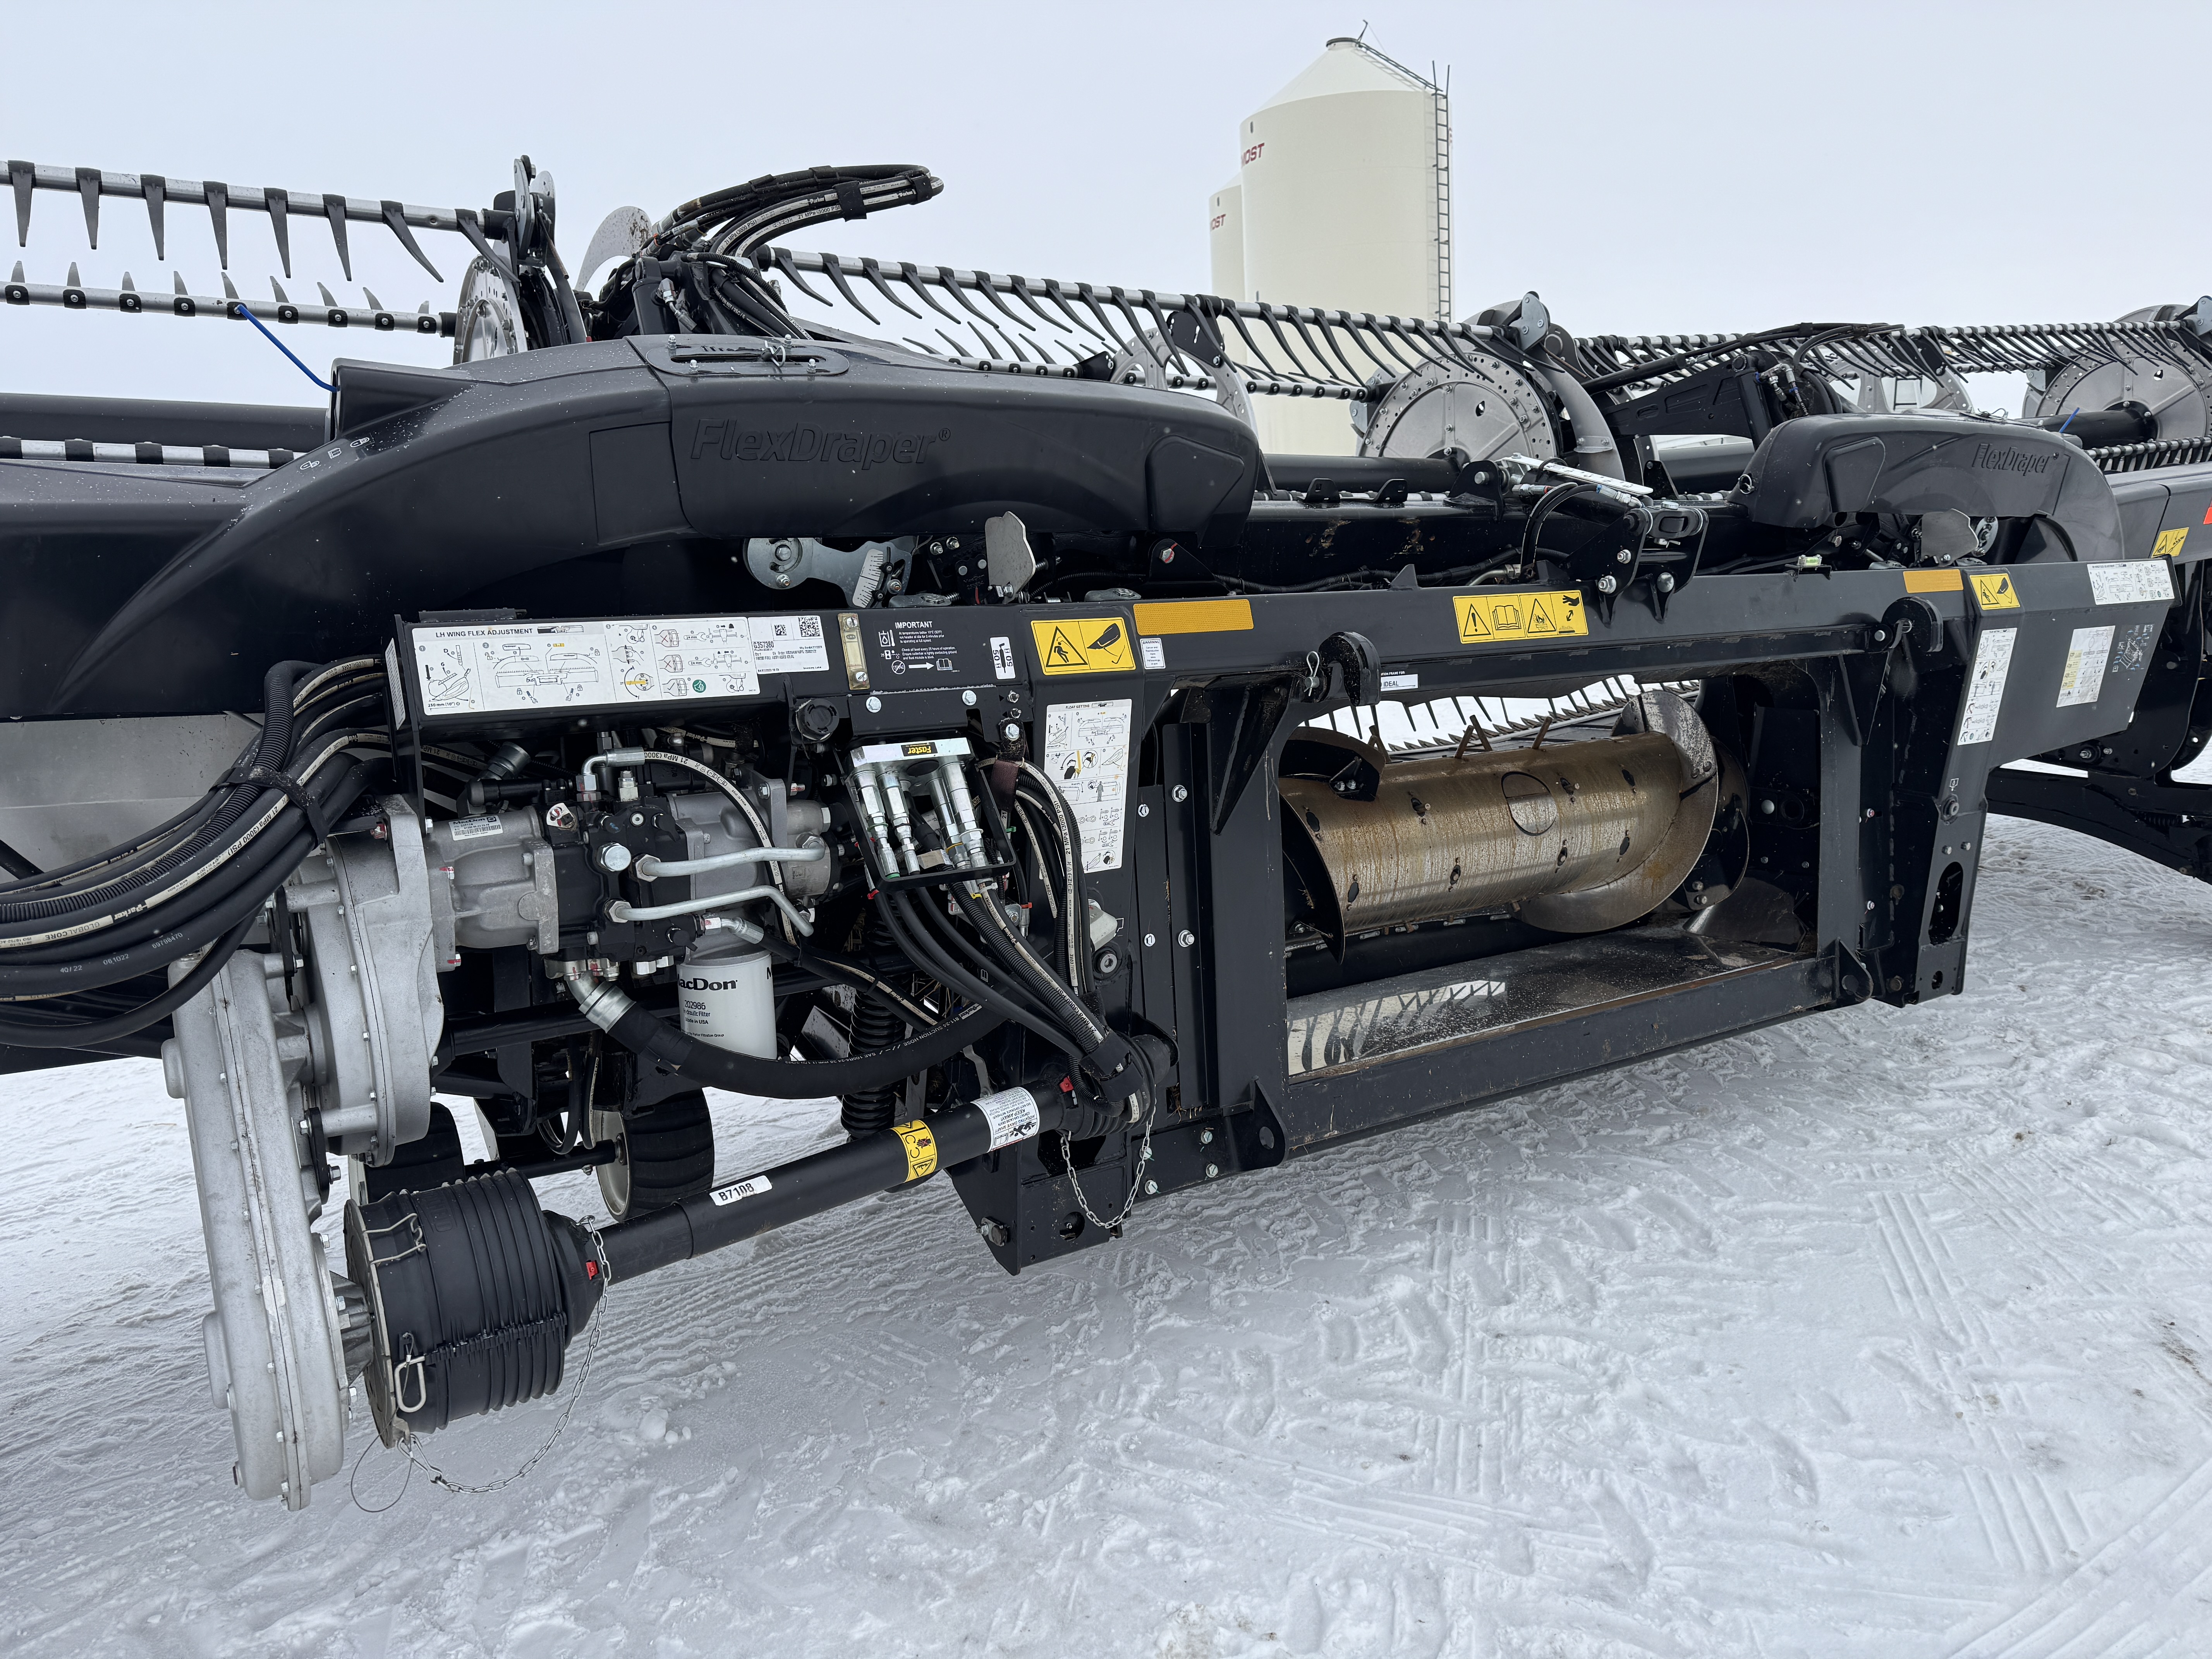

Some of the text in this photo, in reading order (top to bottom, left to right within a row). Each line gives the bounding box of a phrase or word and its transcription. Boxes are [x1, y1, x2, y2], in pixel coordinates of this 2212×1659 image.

[1210, 214, 1226, 231] OST
[736, 225, 747, 235] (3000
[895, 621, 933, 629] IMPORTANT
[993, 649, 1000, 661] 50
[1006, 656, 1013, 667] 50
[907, 746, 931, 754] Faster
[663, 754, 678, 764] MPa
[271, 806, 279, 814] 21
[1053, 800, 1061, 813] PSI)
[259, 814, 272, 827] MPa
[243, 825, 259, 844] (3000
[227, 842, 242, 856] PSI)
[114, 903, 143, 921] Parker
[985, 896, 1001, 923] GLOBALCORE
[45, 921, 100, 941] GLOBALCORE
[678, 974, 737, 991] acDon
[685, 1000, 706, 1010] 202986
[943, 1017, 960, 1027] 811-24
[1079, 1012, 1091, 1026] MPa
[919, 1026, 943, 1040] SUCTION
[903, 1037, 919, 1046] HOSE
[718, 1183, 755, 1201] B7108
